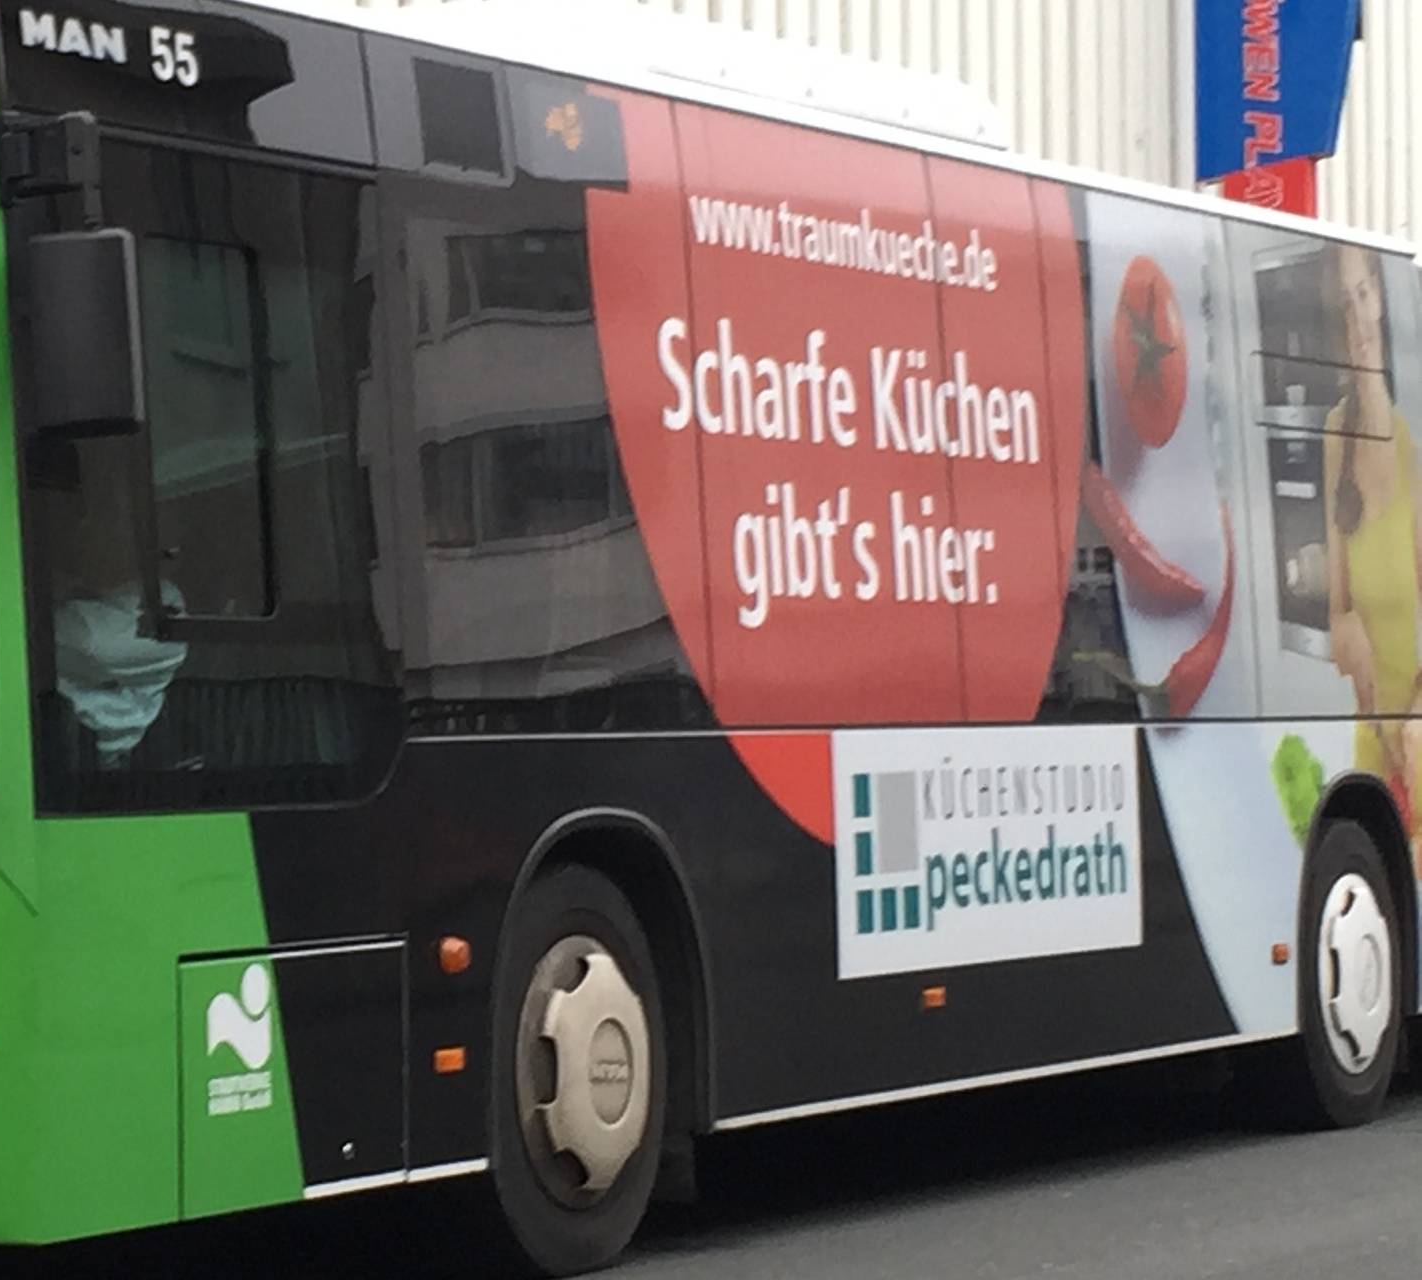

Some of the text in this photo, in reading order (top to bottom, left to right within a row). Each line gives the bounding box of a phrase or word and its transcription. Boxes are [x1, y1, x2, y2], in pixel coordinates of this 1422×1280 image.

[19, 10, 199, 87] MAN 55
[689, 195, 998, 291] www.traumkueche.de
[658, 318, 1039, 463] Scharfe Küchen
[734, 483, 998, 629] gibt's hier:
[923, 757, 1125, 820] KÜCHENSTUDIO
[926, 821, 1127, 932] peckedrath
